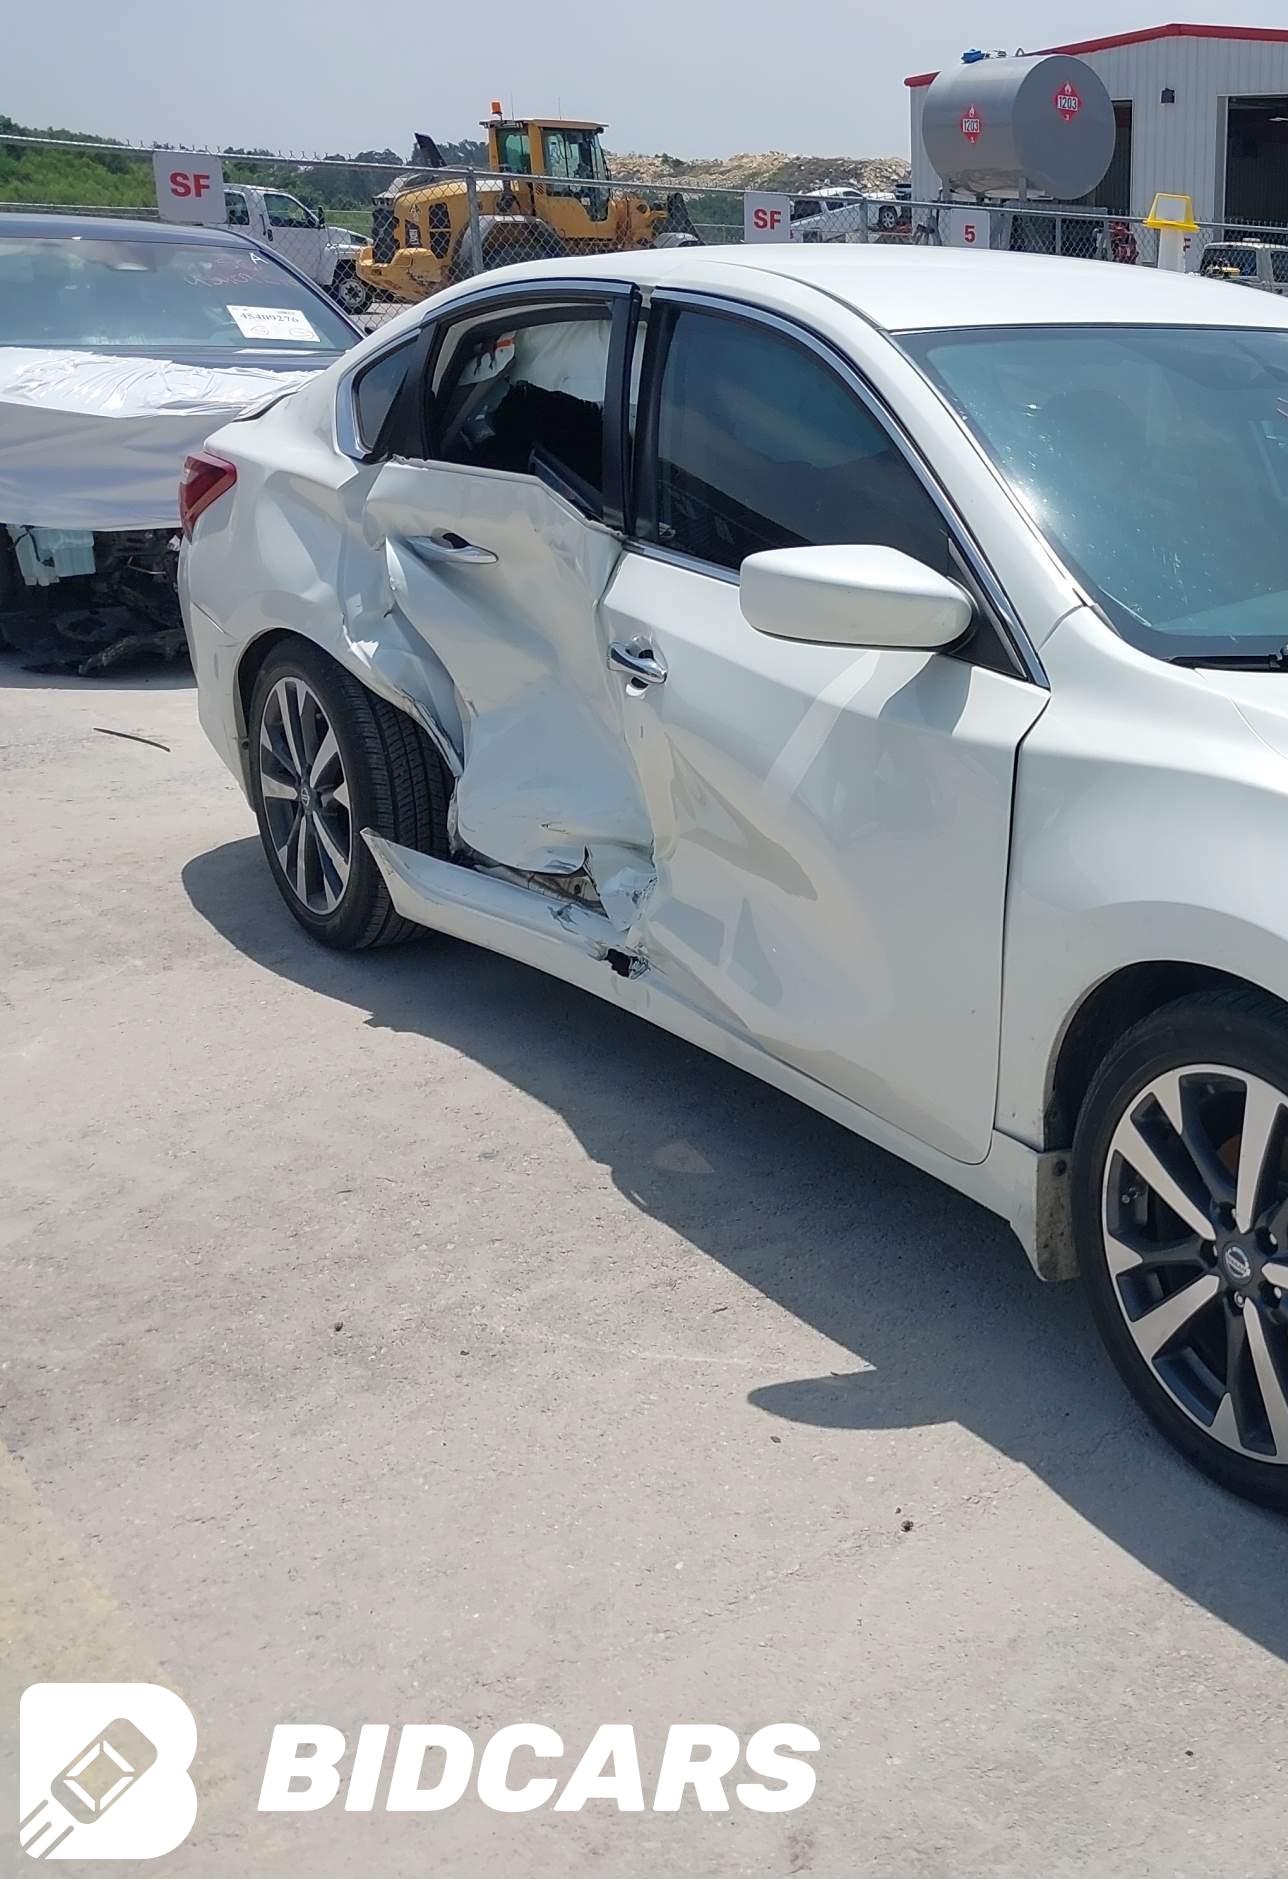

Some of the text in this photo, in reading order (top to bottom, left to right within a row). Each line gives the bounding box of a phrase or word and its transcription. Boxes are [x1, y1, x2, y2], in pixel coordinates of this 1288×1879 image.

[1058, 95, 1077, 110] 1203
[963, 119, 979, 132] 1203
[169, 172, 210, 198] SF
[753, 208, 782, 230] SF
[964, 225, 976, 243] 5
